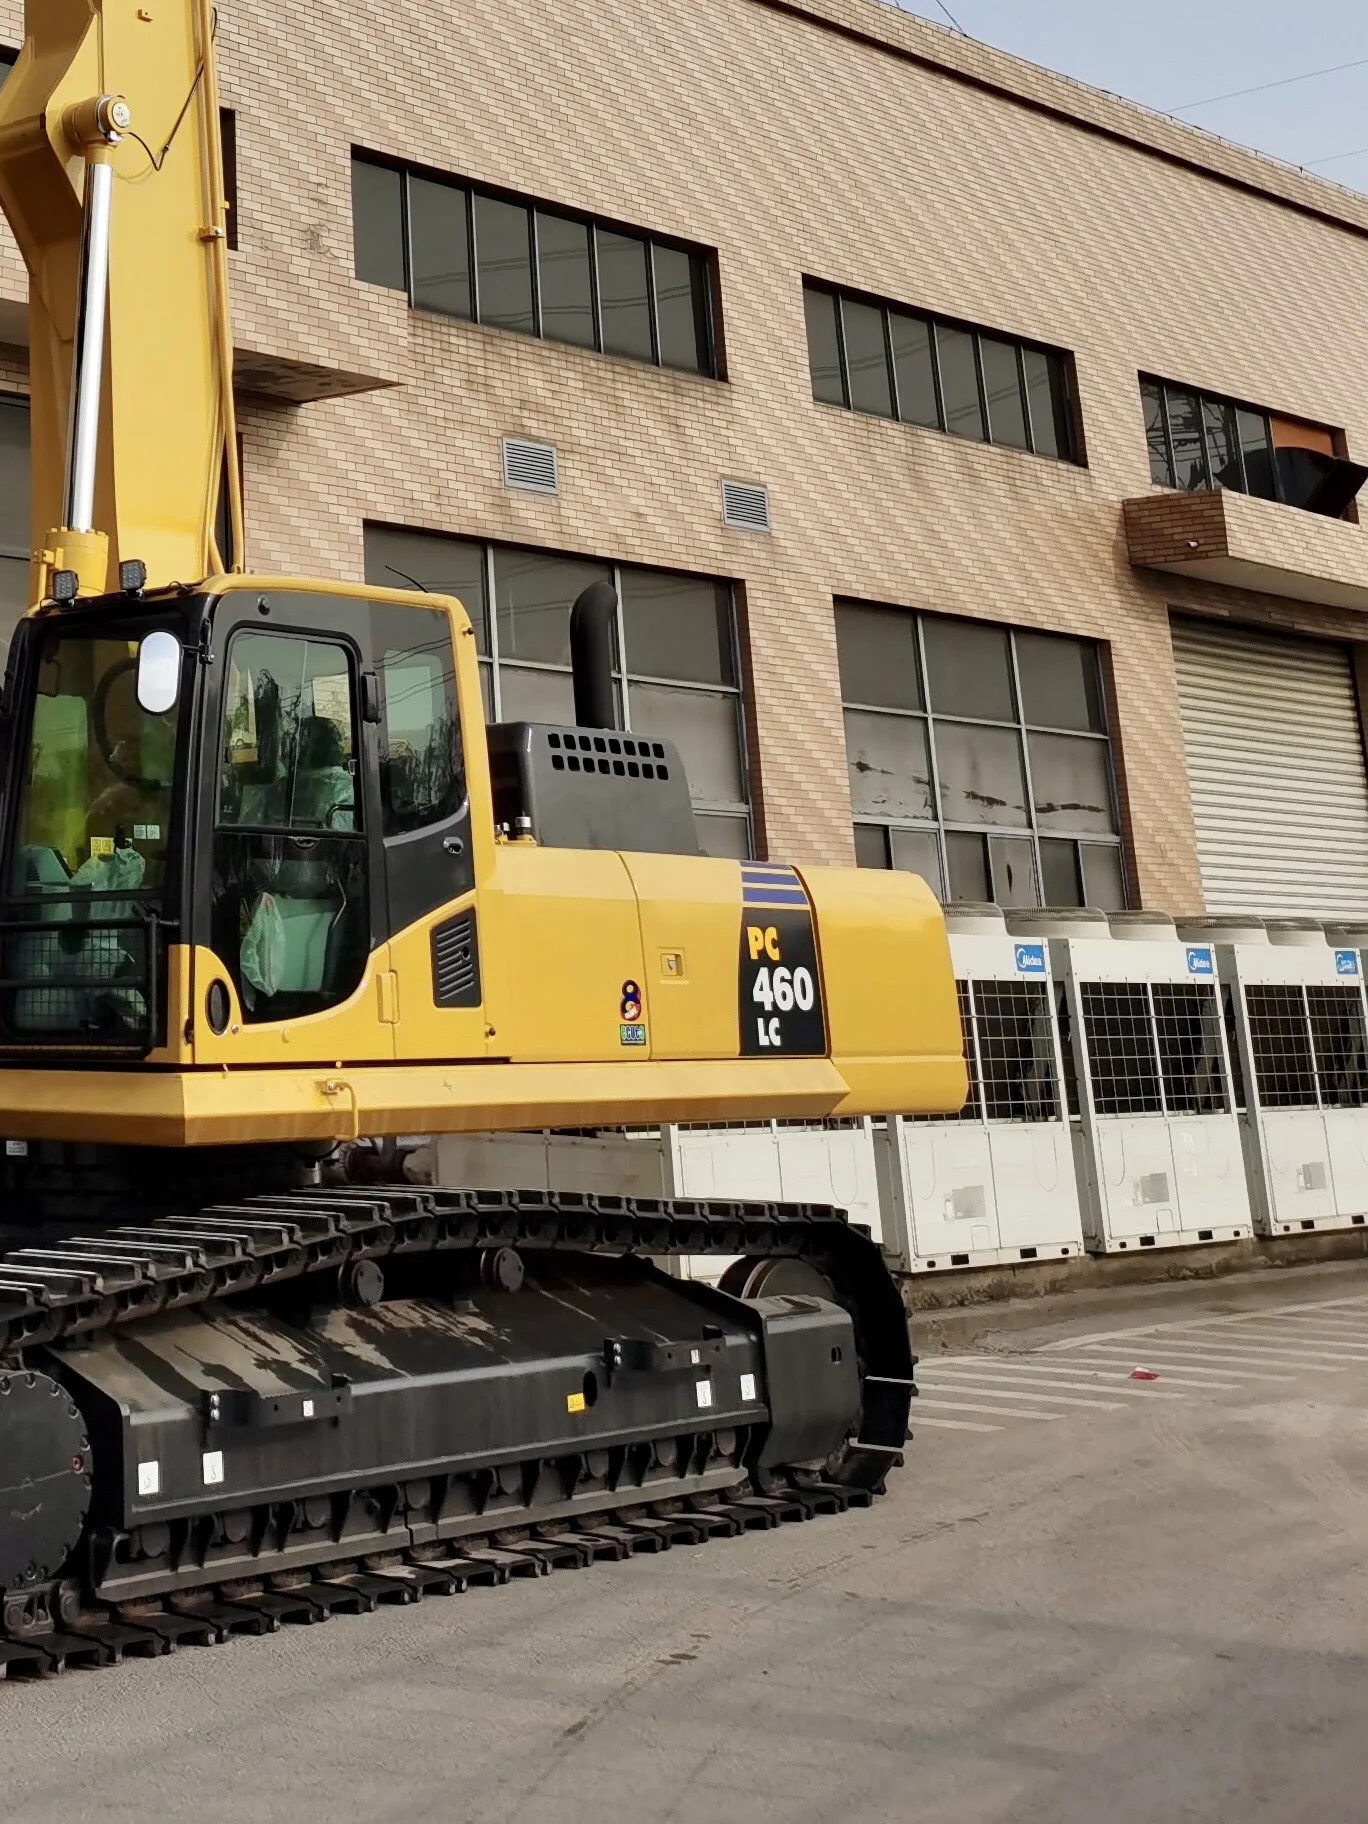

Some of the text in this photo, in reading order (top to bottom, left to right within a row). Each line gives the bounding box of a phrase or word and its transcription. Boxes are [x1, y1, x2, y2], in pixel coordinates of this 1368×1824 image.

[747, 926, 780, 961] PC
[752, 966, 814, 1011] 460
[757, 1017, 782, 1047] LC
